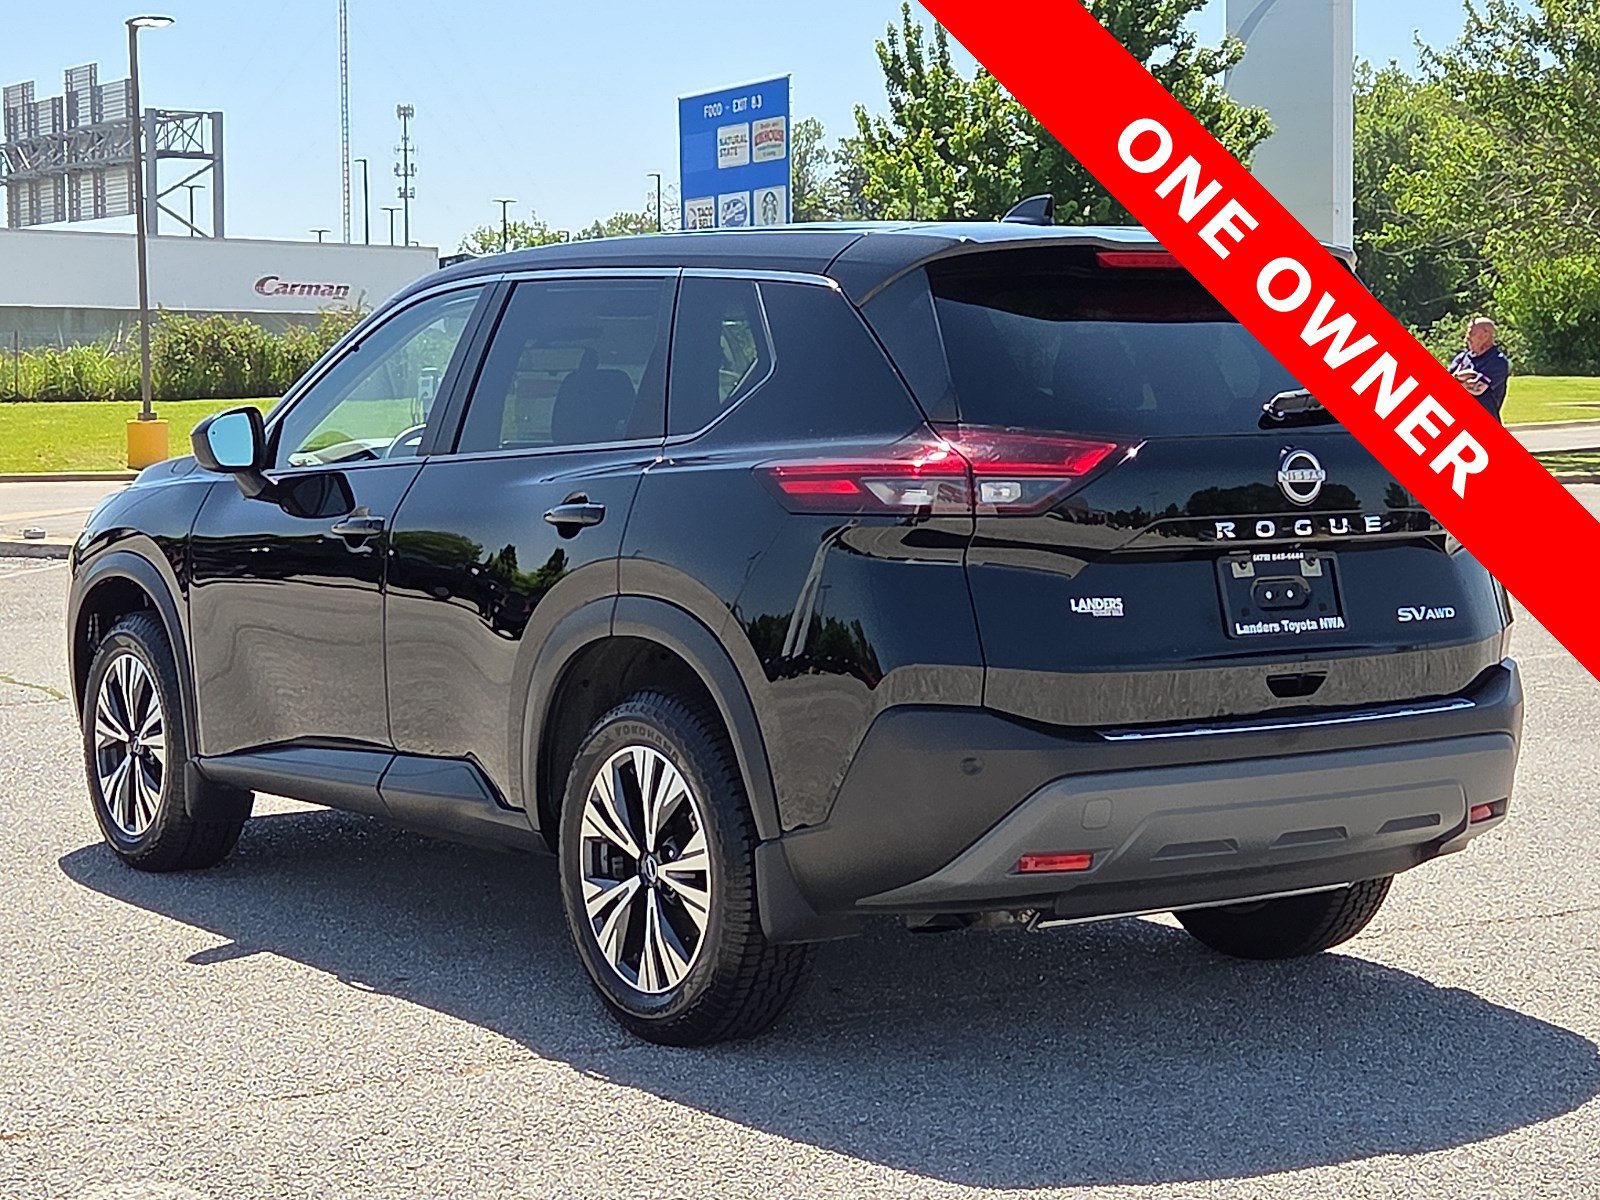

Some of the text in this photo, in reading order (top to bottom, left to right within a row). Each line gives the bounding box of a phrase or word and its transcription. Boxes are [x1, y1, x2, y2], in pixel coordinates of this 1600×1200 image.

[704, 102, 723, 119] FOOD
[732, 97, 748, 113] EXIT
[719, 134, 748, 147] NATURAL
[719, 146, 738, 158] STATE
[697, 206, 713, 217] TACO
[698, 218, 713, 229] BELL
[254, 276, 350, 296] Carman
[1278, 469, 1325, 482] NISSAN
[1215, 515, 1382, 539] ROGUE
[1070, 597, 1123, 612] LANDERS
[1397, 606, 1455, 621] SV AWD
[1235, 616, 1345, 635] Landers Toyota NWA
[614, 724, 680, 763] YOKOHAMA
